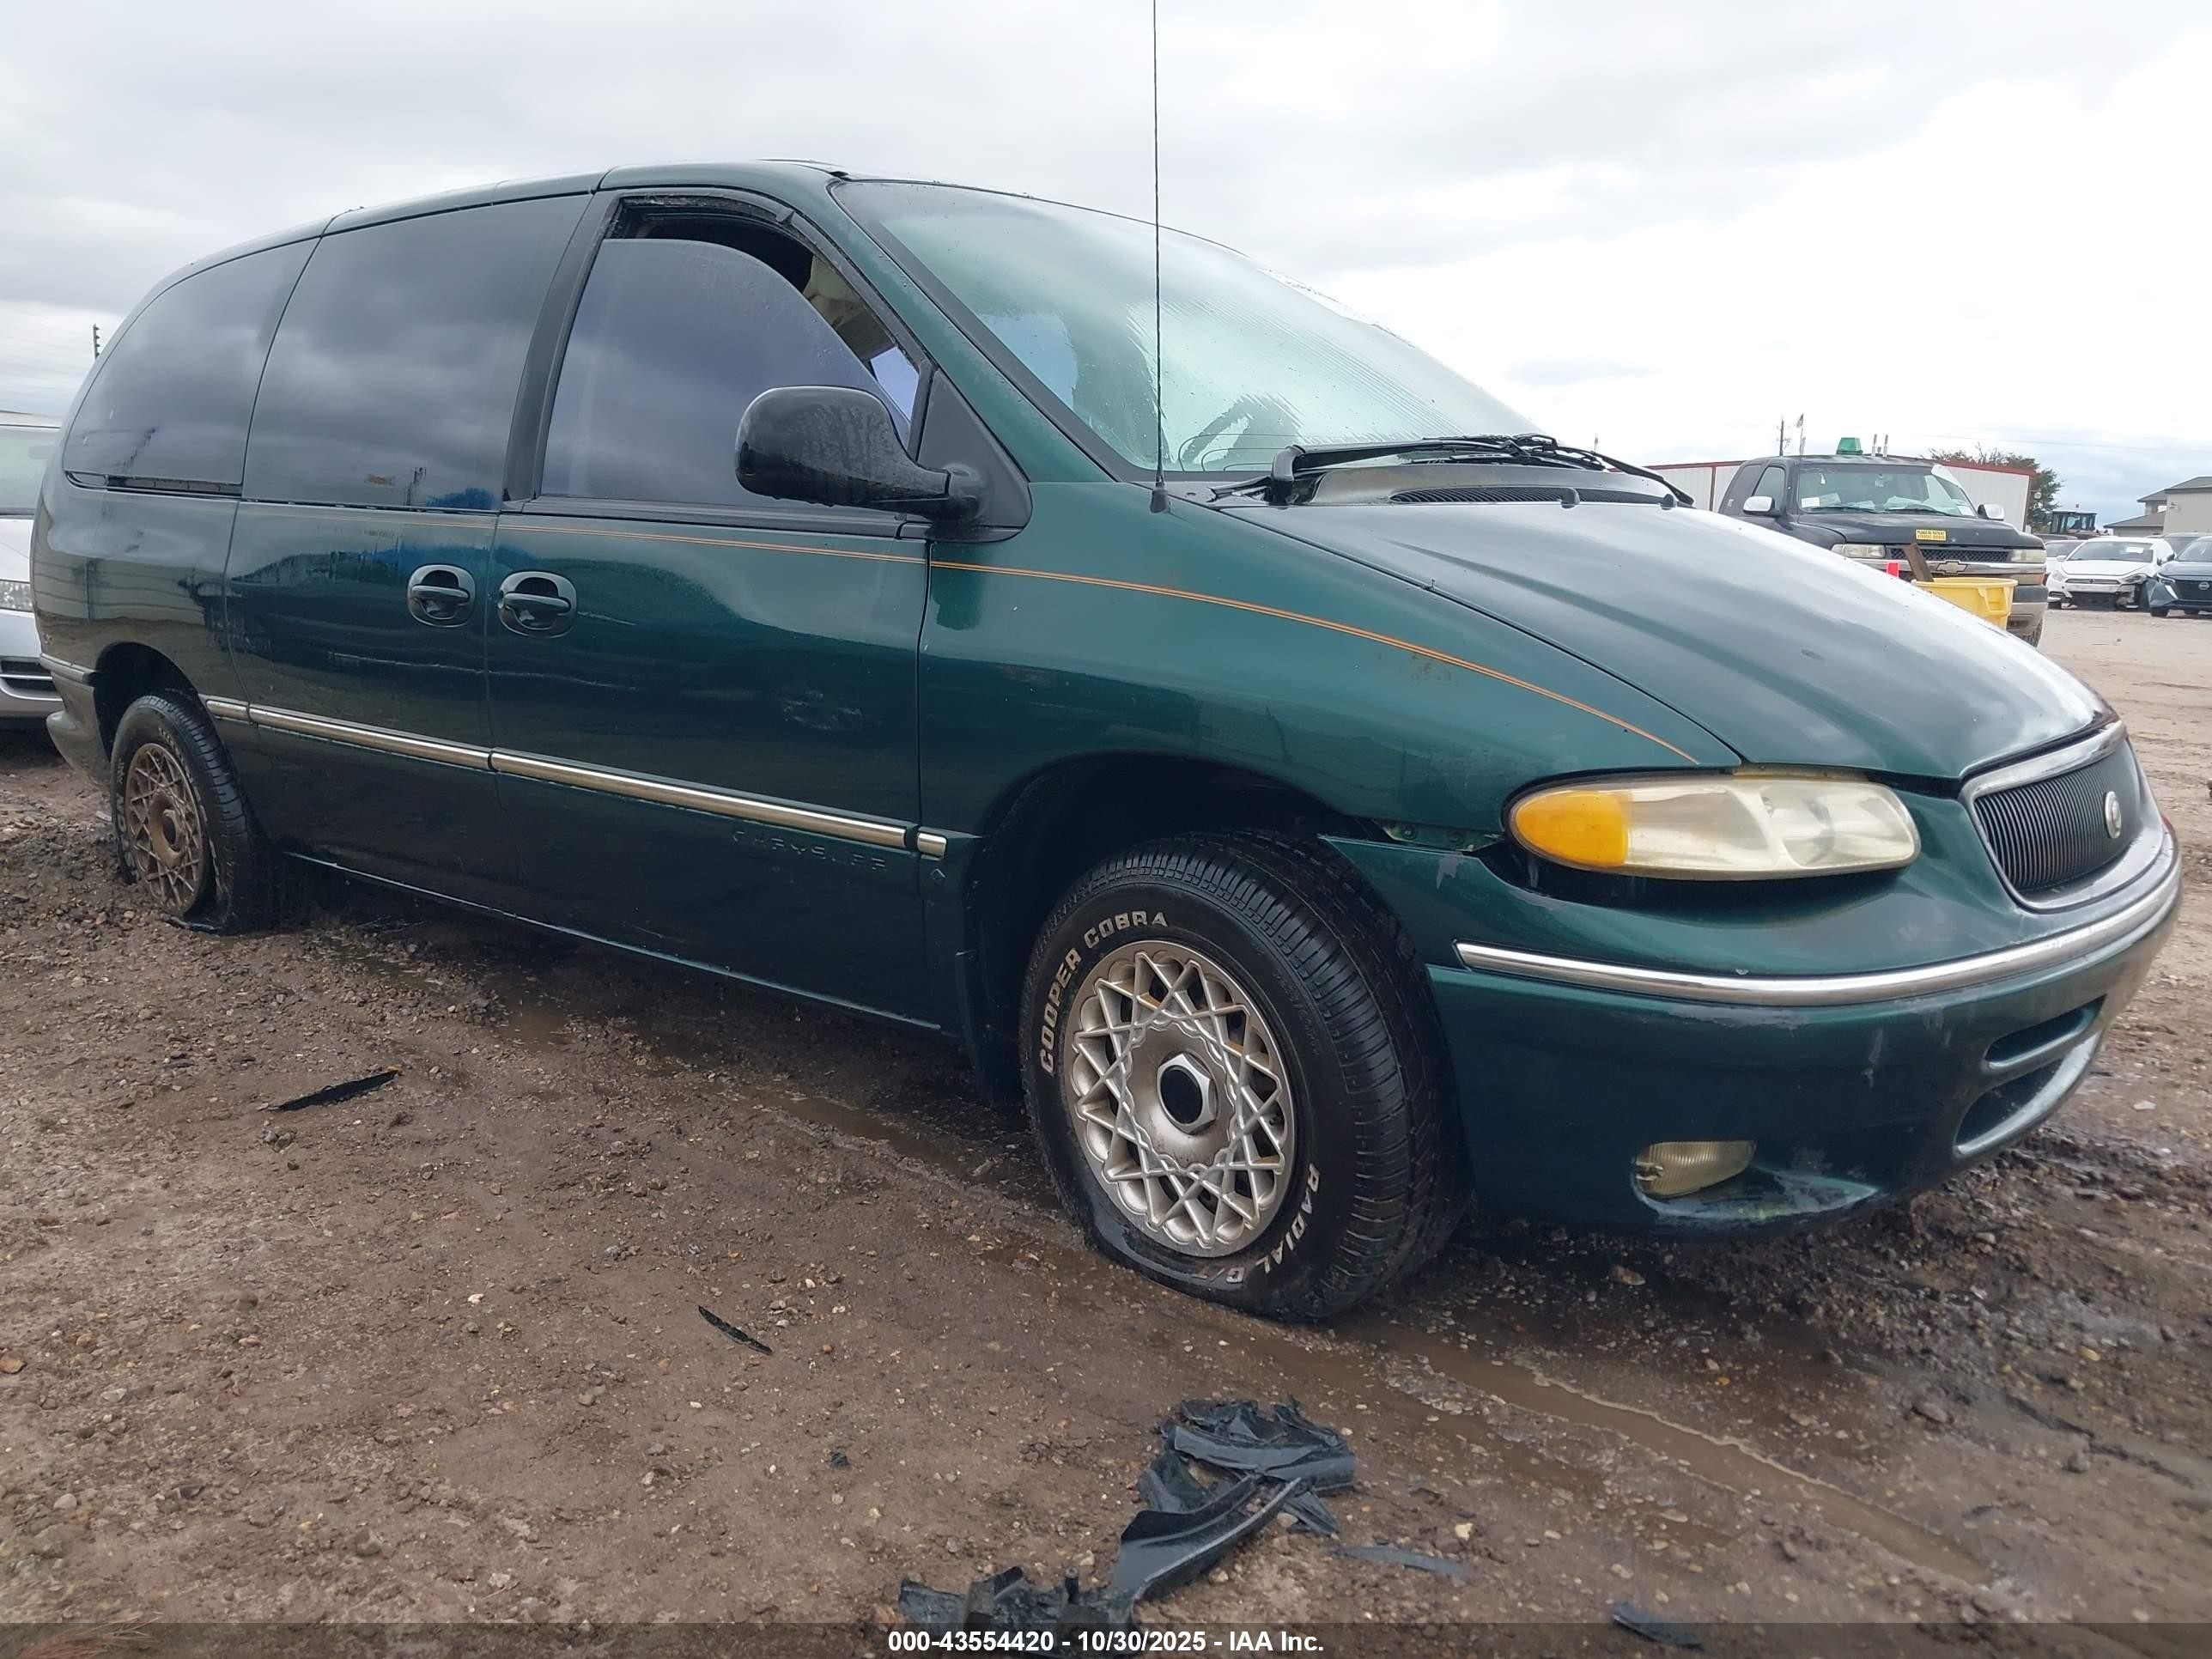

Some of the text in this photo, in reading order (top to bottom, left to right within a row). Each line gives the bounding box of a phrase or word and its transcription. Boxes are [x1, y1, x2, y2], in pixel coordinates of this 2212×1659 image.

[1040, 910, 1169, 1073] COOPER COBRA
[1255, 1163, 1322, 1274] RADIAL
